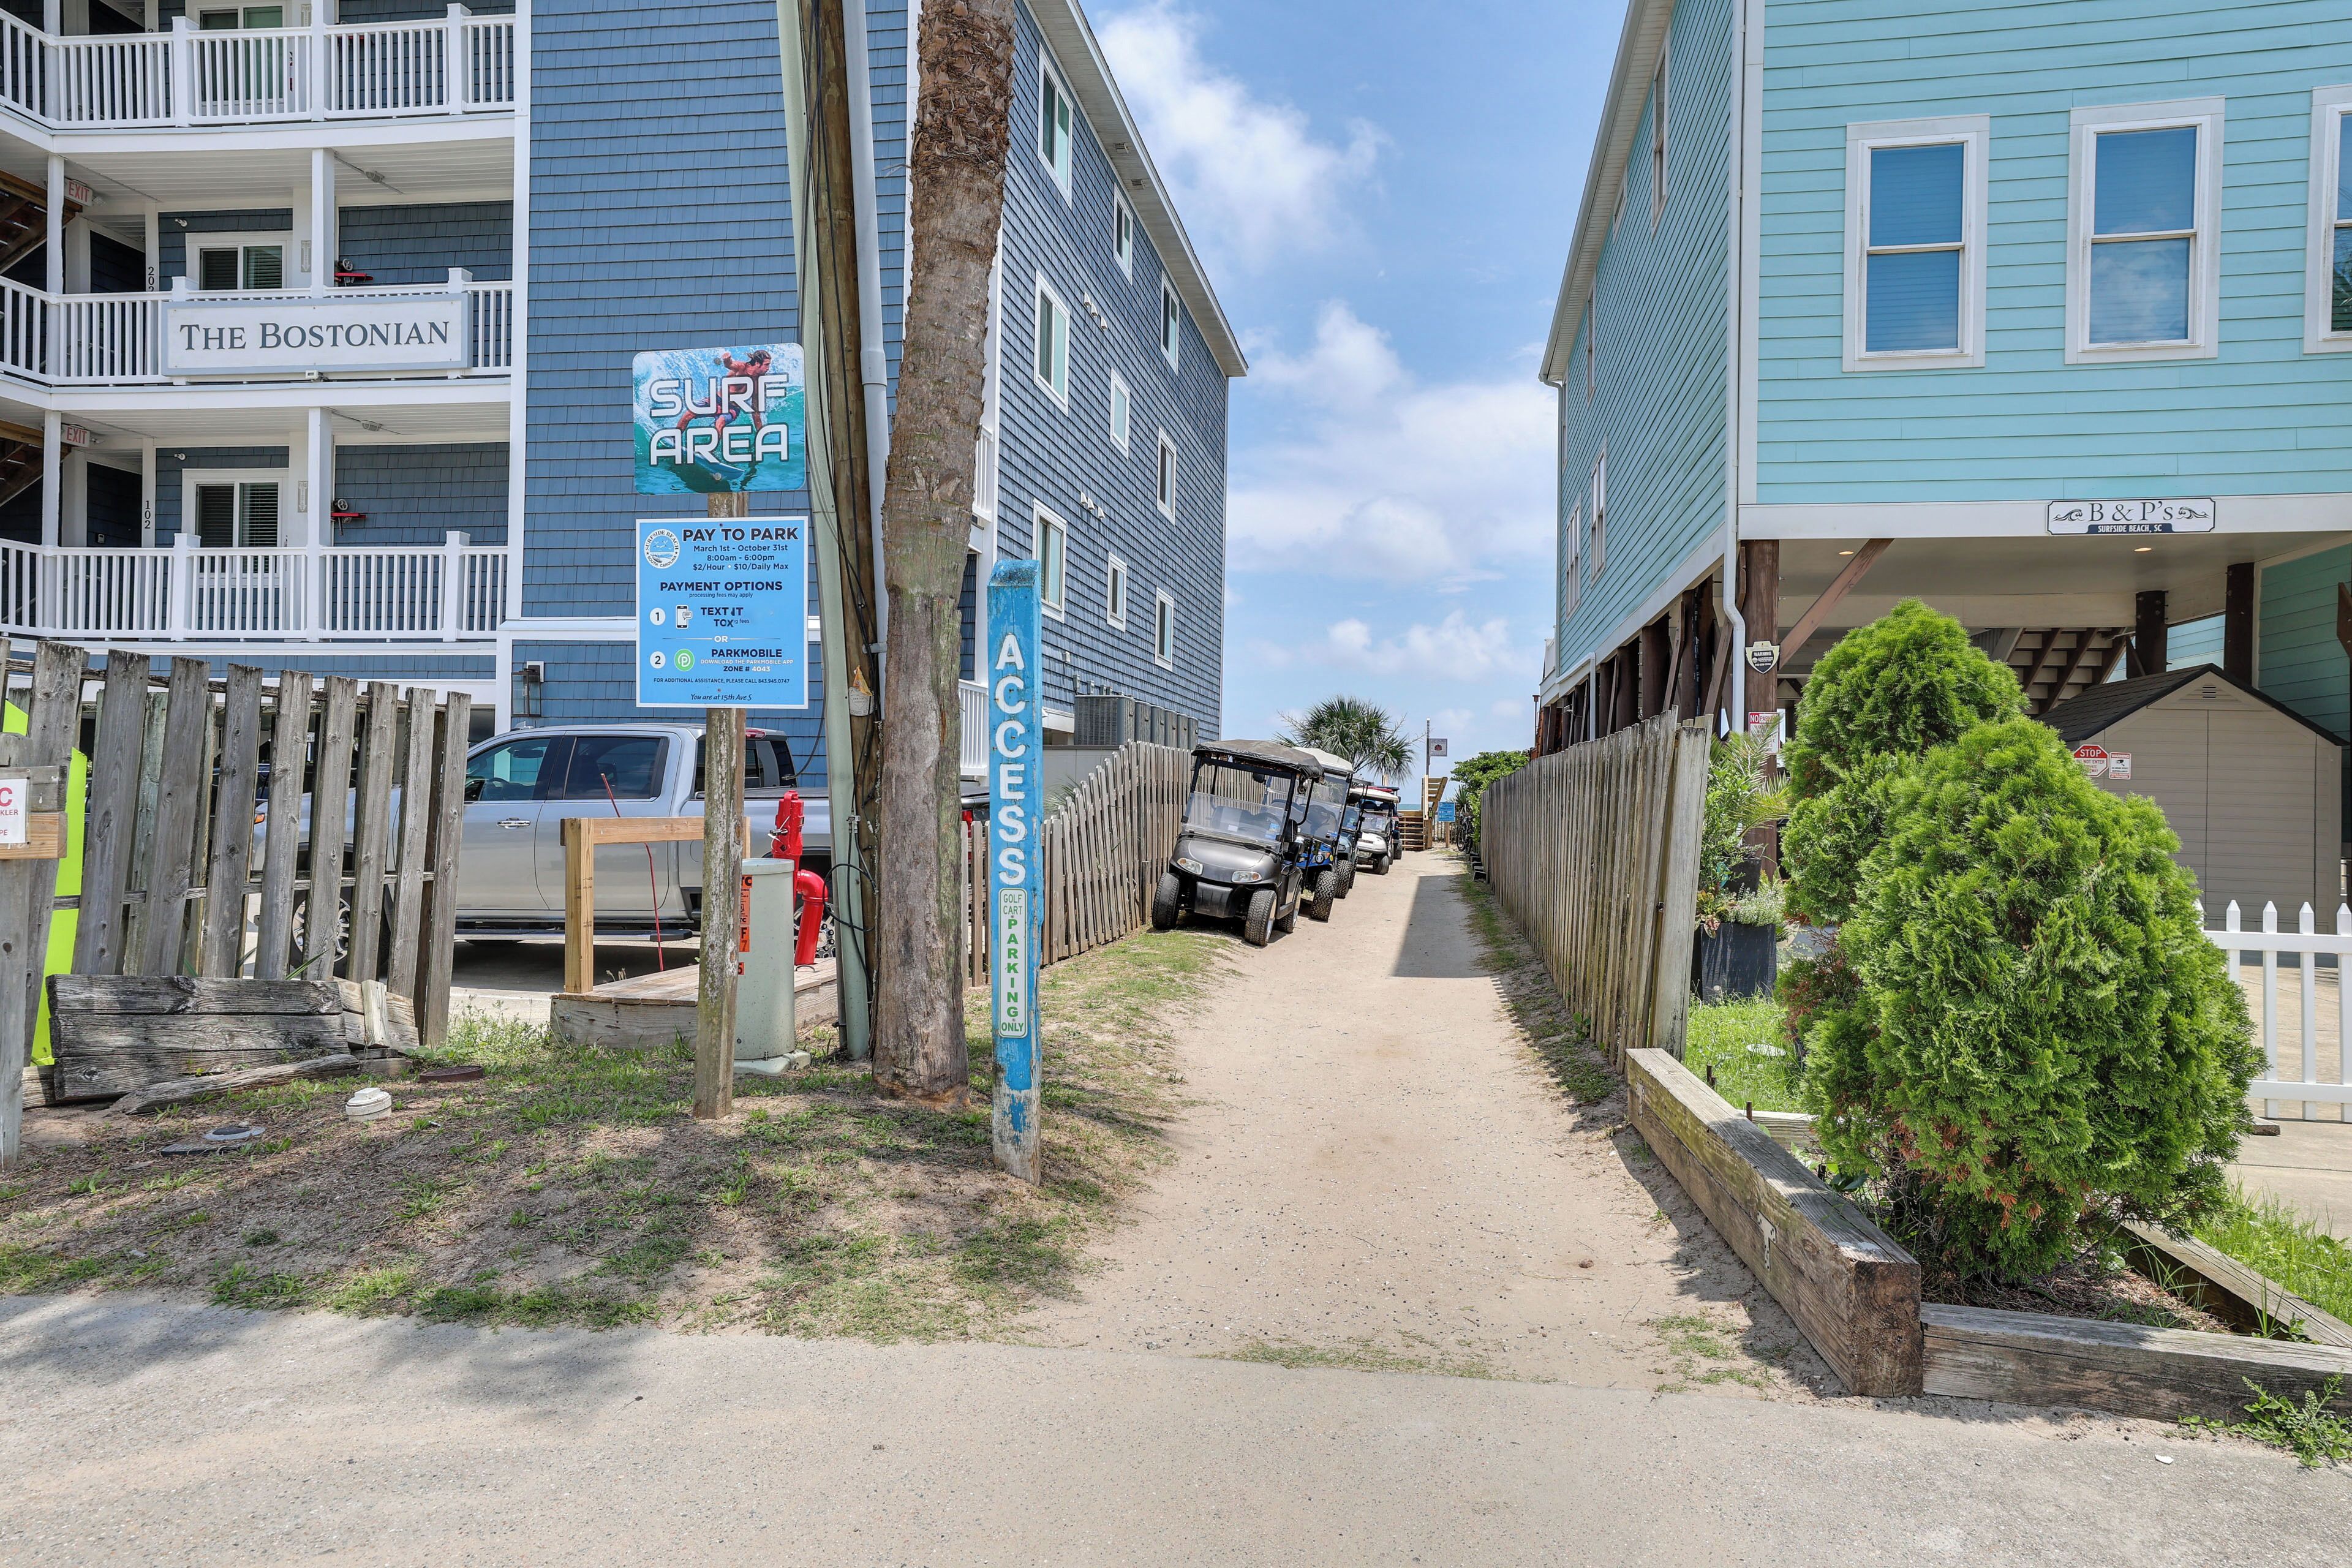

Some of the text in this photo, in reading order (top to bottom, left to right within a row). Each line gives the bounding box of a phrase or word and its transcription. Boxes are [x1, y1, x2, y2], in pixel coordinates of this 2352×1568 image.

[69, 182, 89, 202] EXIT
[180, 321, 450, 350] THE BOSTONIAN
[650, 373, 788, 417] SURF
[66, 427, 87, 444] EXIT
[650, 423, 788, 465] AREA
[2088, 501, 2173, 521] B & P's
[682, 527, 799, 541] PAY TO PARK
[2129, 524, 2152, 533] BEACH,
[646, 530, 679, 550] SURFSIDE BEACH
[647, 556, 677, 567] SOUTH CAROLINA
[660, 581, 783, 591] PAYMENT OPTIONS
[655, 612, 660, 621] 1
[701, 607, 729, 616] TEXT
[711, 649, 782, 658] PARKMOBILE
[654, 655, 661, 665] 2
[994, 632, 1026, 886] ACCESS
[1003, 894, 1022, 903] GOLF
[1003, 906, 1022, 915] CART
[1007, 919, 1019, 1017] PARKING
[1001, 1022, 1023, 1031] ONLY
